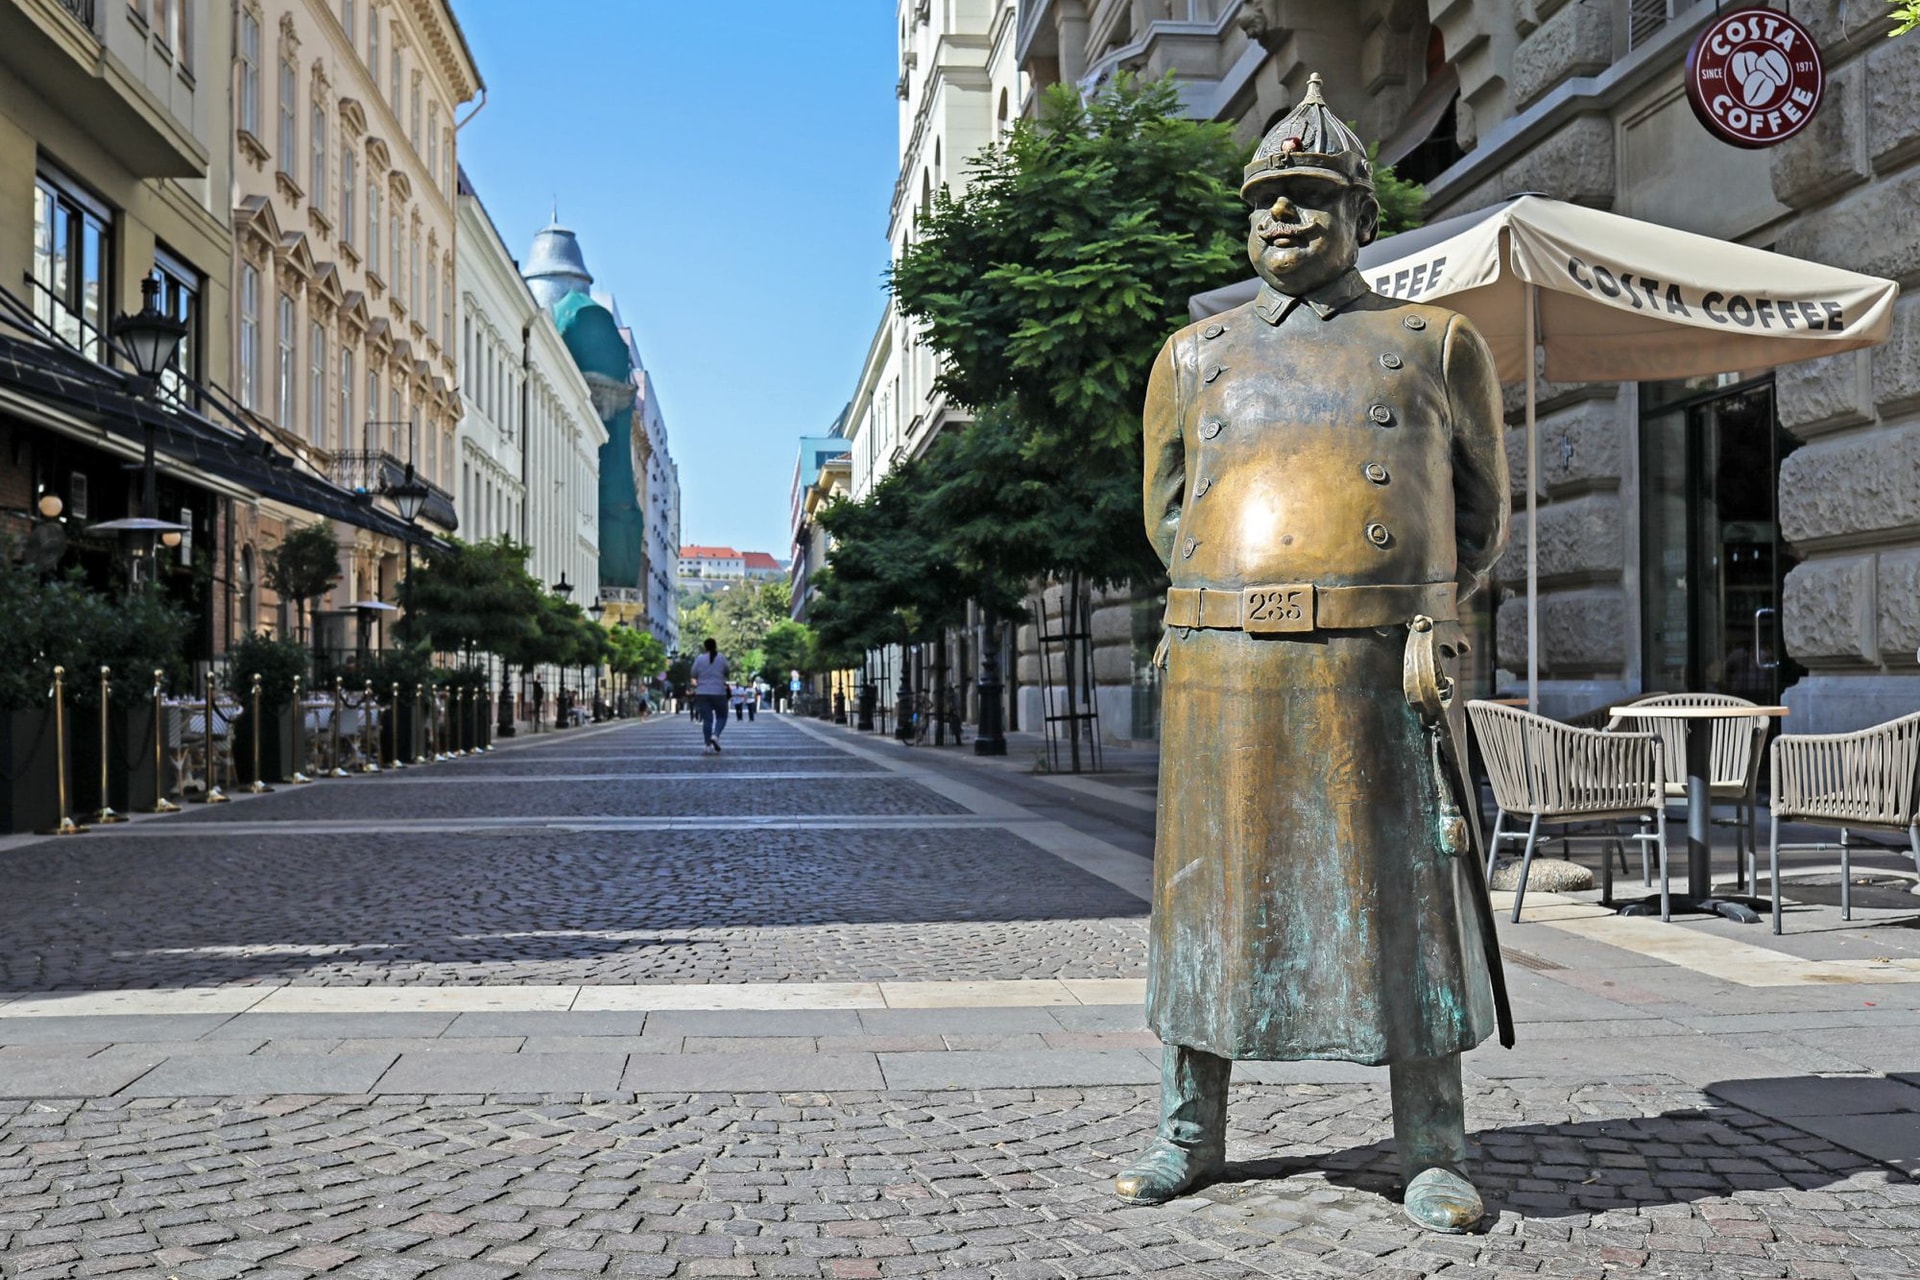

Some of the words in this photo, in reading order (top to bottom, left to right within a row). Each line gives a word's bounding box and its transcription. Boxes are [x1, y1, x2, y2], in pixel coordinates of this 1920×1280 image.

[1711, 17, 1796, 56] COSTA
[1701, 68, 1723, 80] SINCE
[1795, 61, 1813, 73] 1971
[1712, 86, 1814, 135] COFFEE
[1568, 256, 1692, 318] COSTA
[1702, 291, 1844, 331] COFFEE
[1249, 591, 1303, 621] 235
